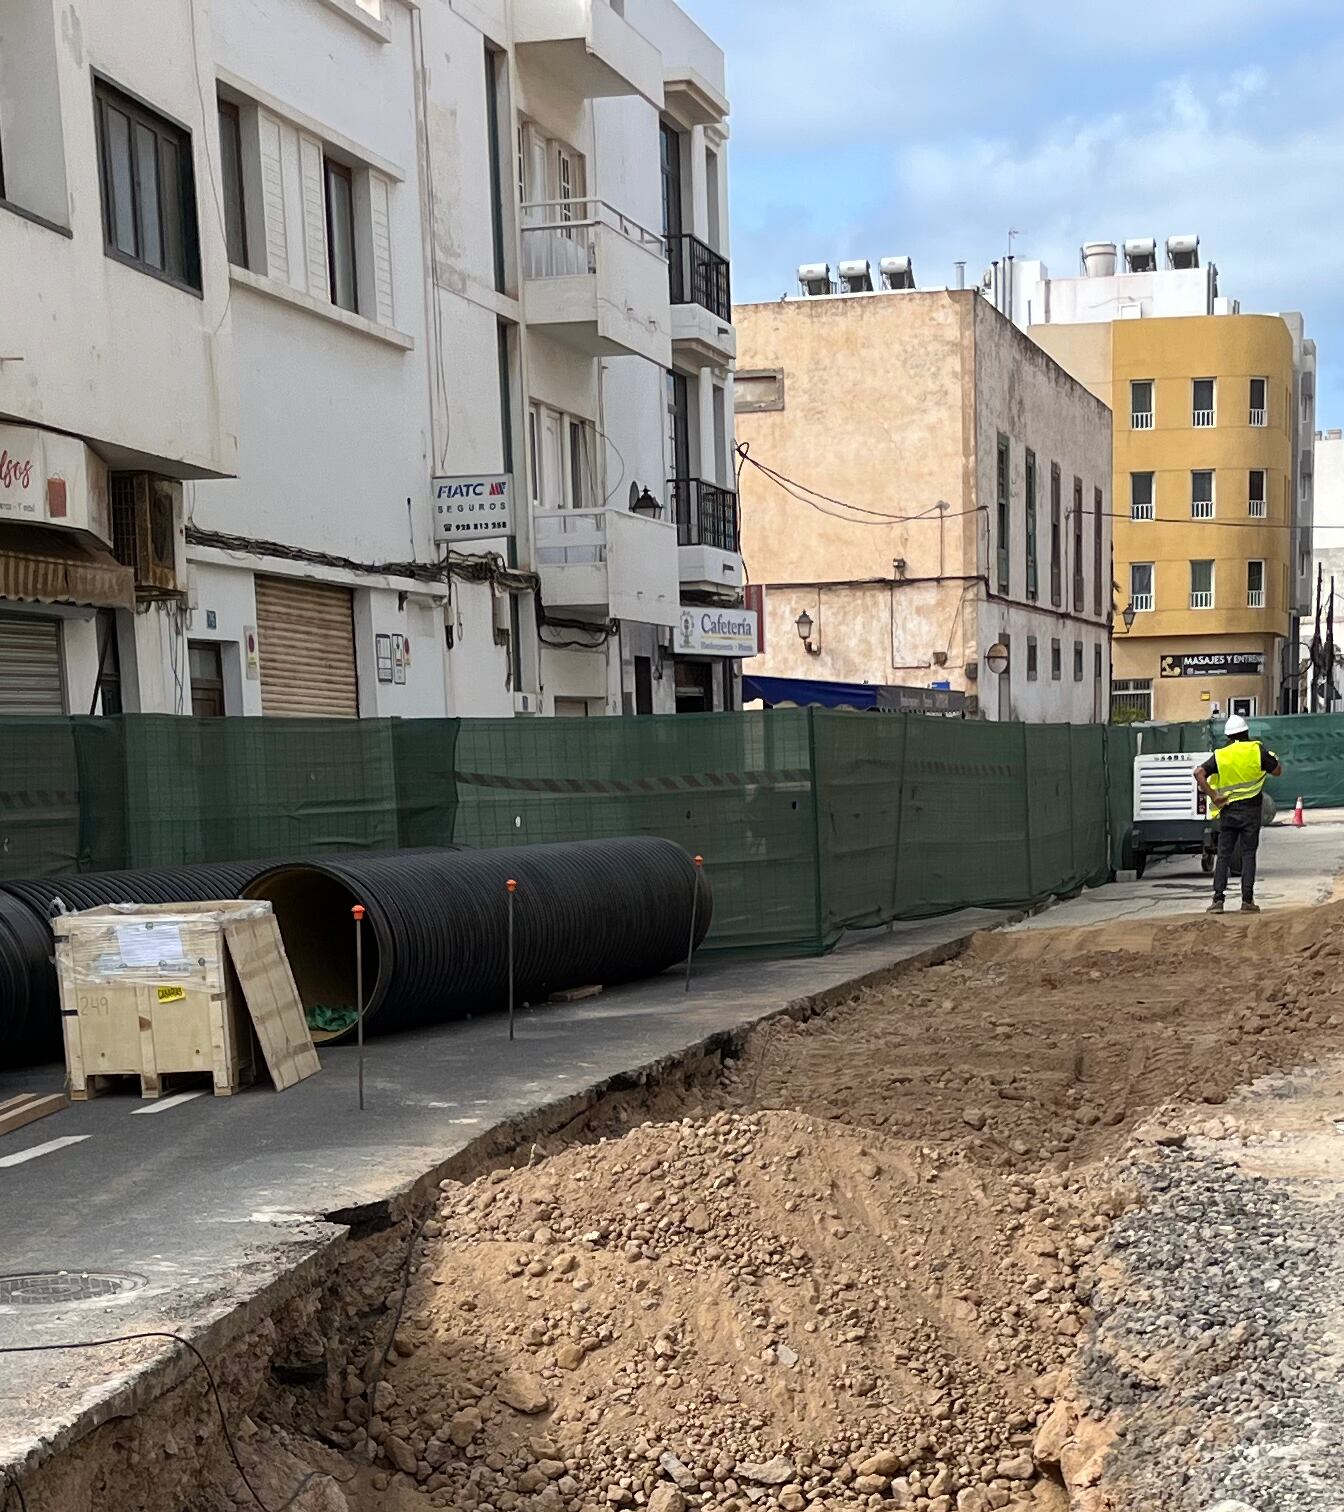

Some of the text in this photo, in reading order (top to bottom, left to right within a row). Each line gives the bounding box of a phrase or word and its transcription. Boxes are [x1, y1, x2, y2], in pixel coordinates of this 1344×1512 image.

[437, 483, 485, 499] FIATC
[438, 502, 506, 514] SEGUROS
[701, 613, 752, 636] Cafetería
[1184, 655, 1225, 666] MASAJES
[1226, 655, 1233, 664] Y
[80, 996, 109, 1016] 249
